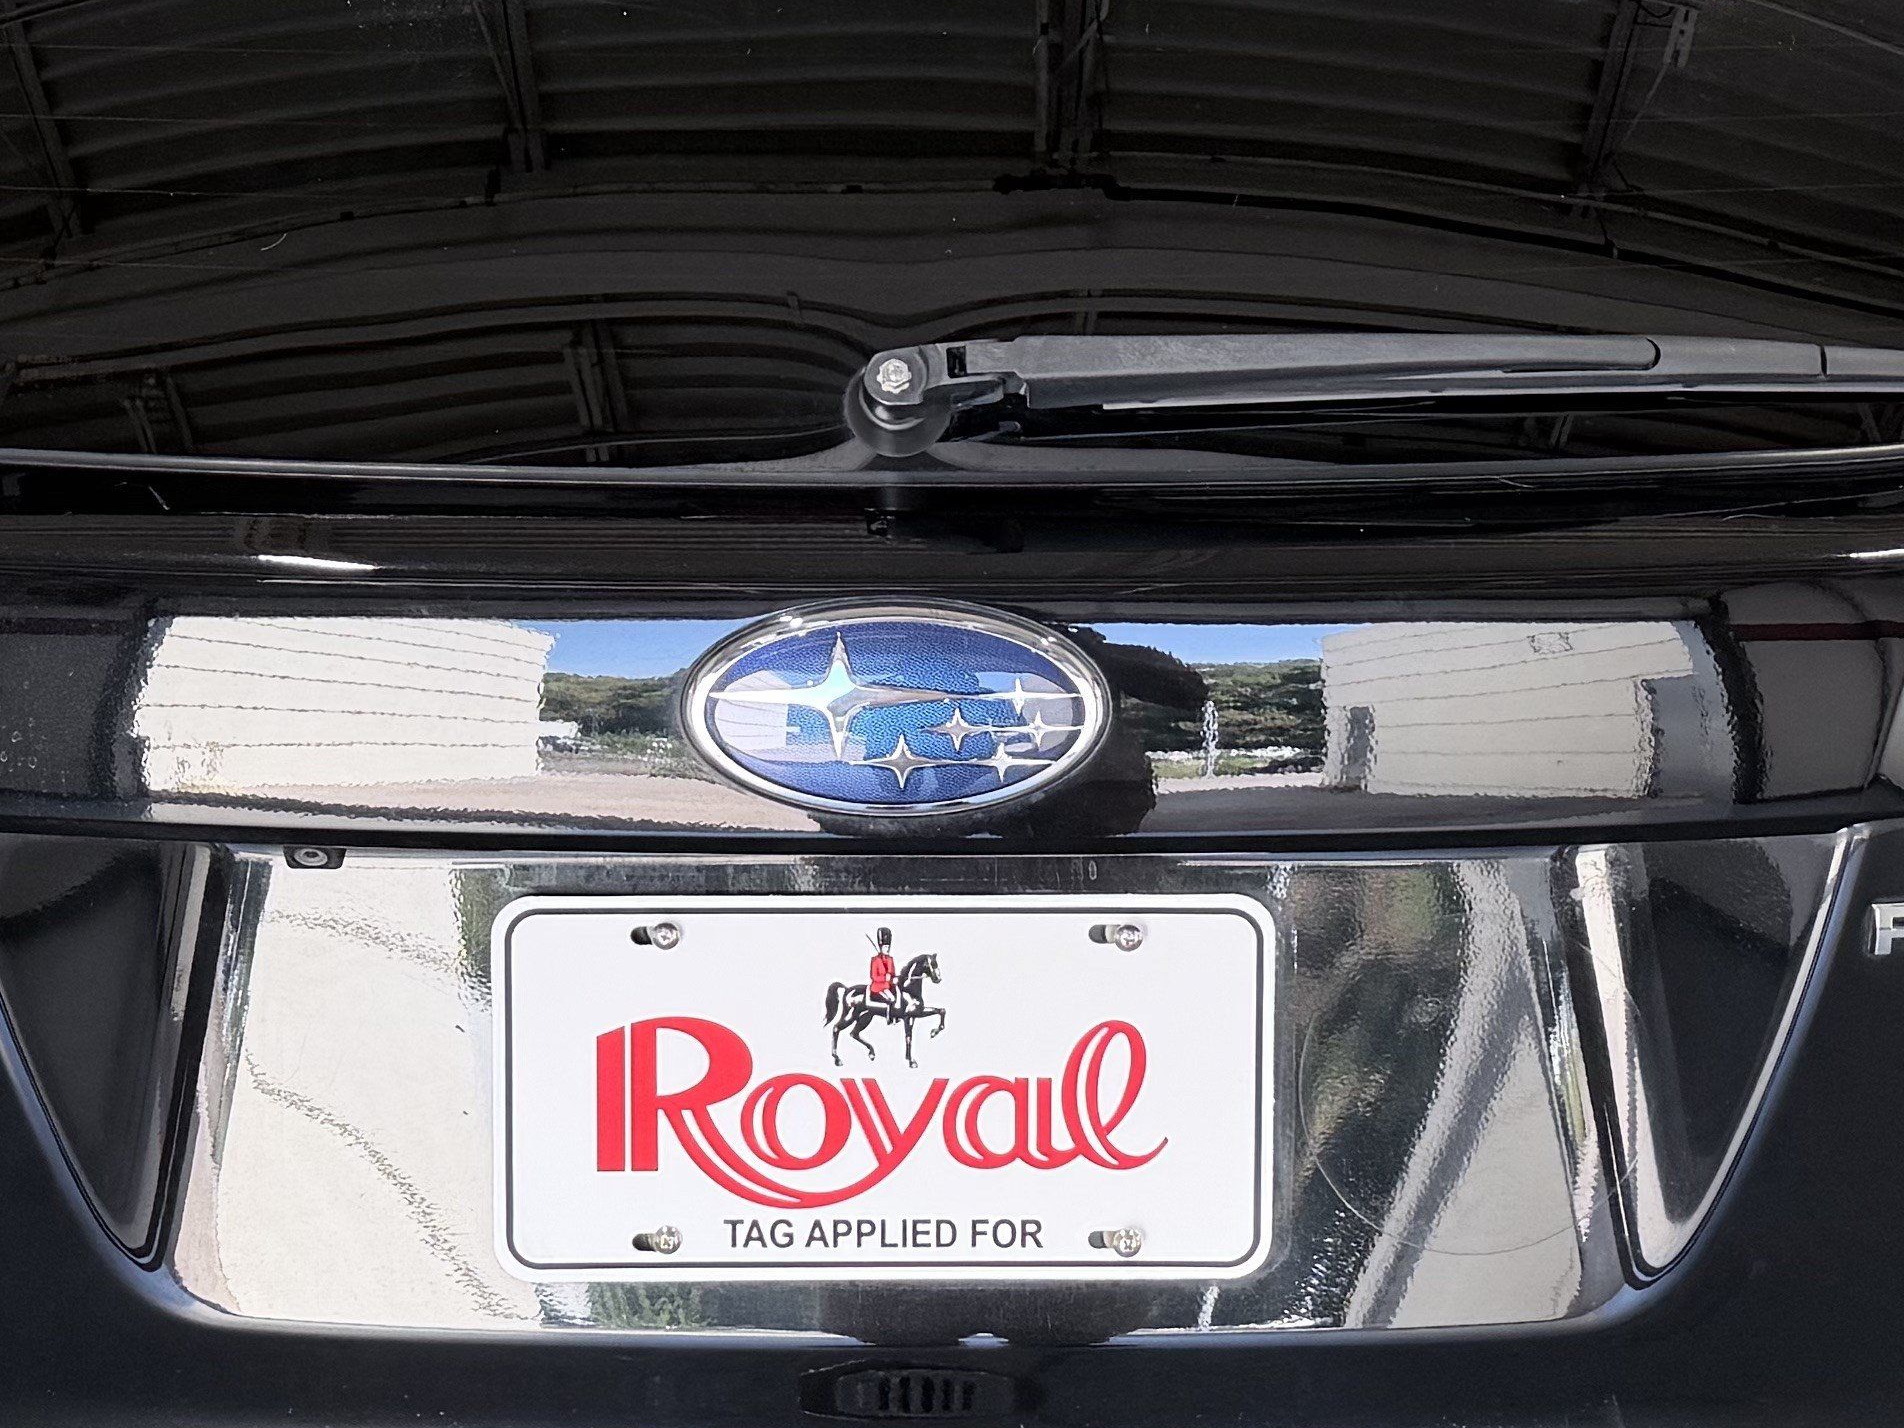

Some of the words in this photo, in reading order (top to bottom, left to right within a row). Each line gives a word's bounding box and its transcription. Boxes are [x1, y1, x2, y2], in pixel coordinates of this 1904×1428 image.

[595, 1015, 1169, 1210] Royal
[723, 1217, 798, 1250] TAG
[804, 1217, 959, 1250] APPLIED
[970, 1217, 1043, 1250] FOR
